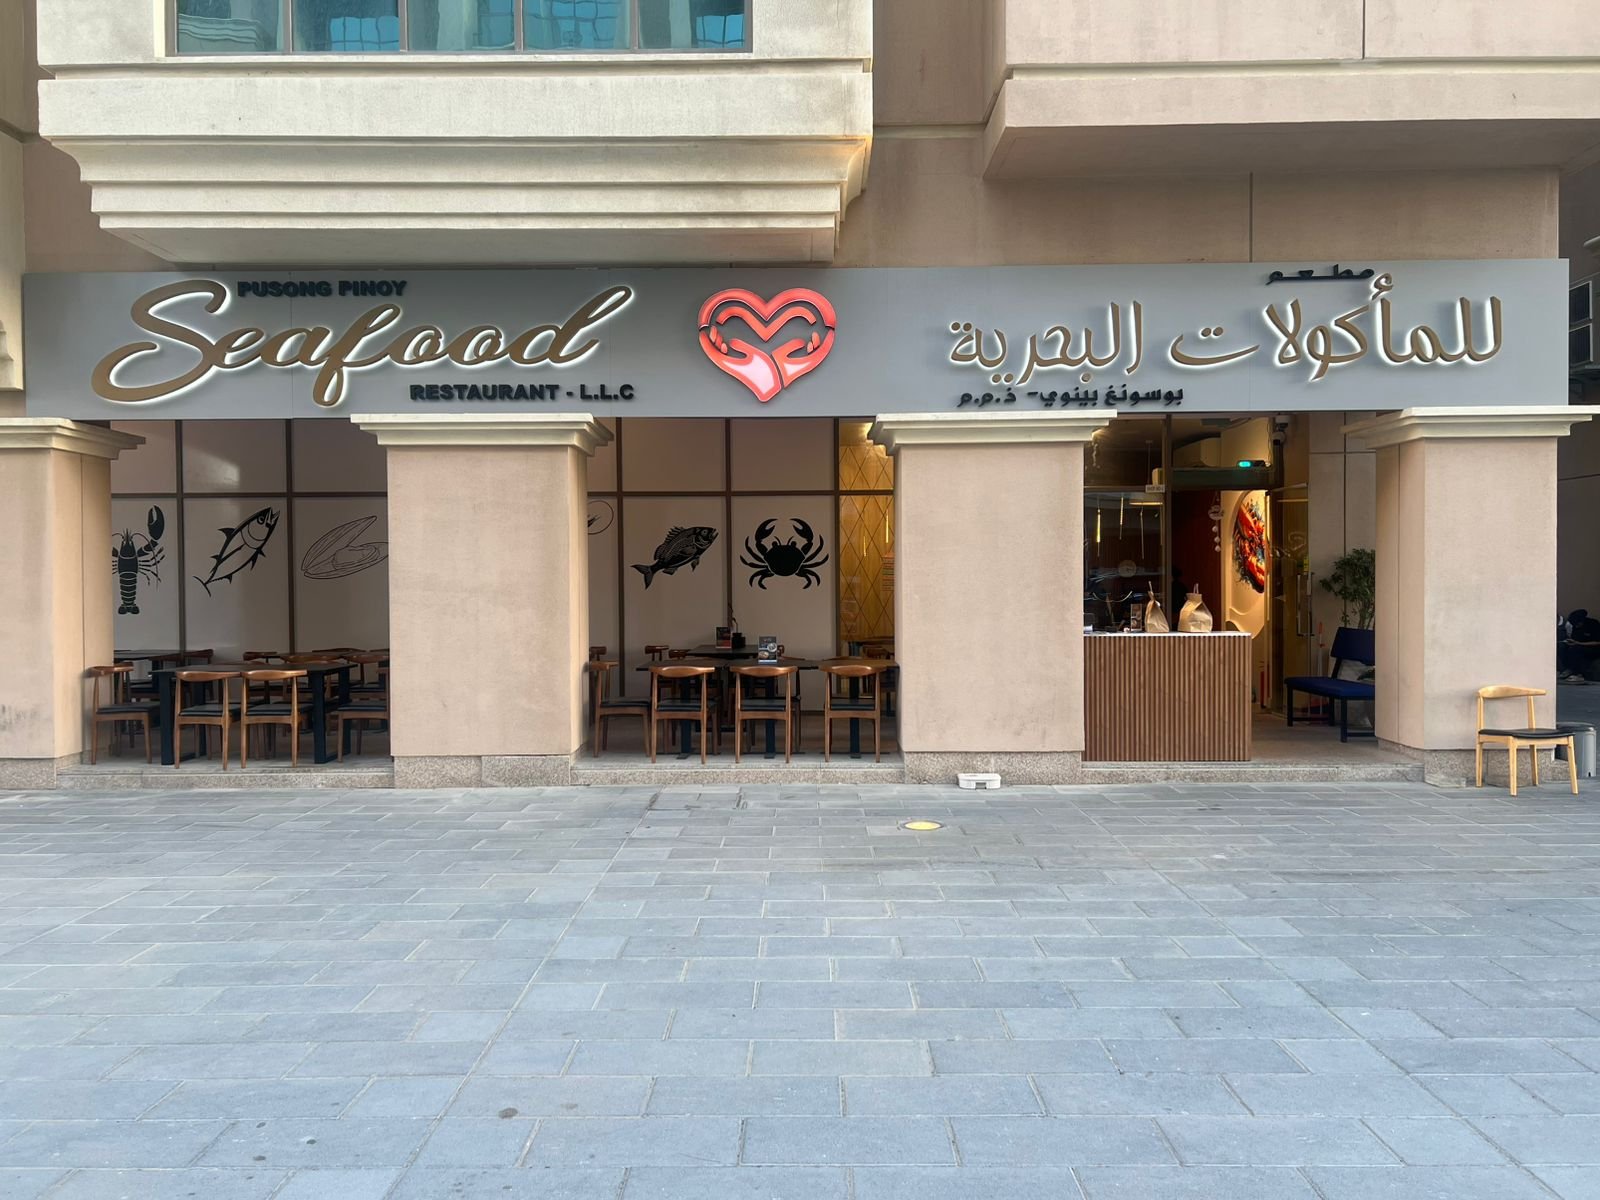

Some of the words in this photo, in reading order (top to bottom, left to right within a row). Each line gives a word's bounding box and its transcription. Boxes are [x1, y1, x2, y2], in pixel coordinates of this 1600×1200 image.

[1265, 263, 1375, 286] مطعم
[237, 281, 332, 298] PUSONG
[338, 280, 407, 297] PINOY
[1167, 272, 1502, 382] للمأكولات
[91, 279, 633, 407] Seafood
[949, 300, 1143, 386] البحرية
[409, 384, 559, 401] RESTAURANT
[580, 384, 634, 401] L.L.C
[1103, 384, 1184, 406] بوسونغ
